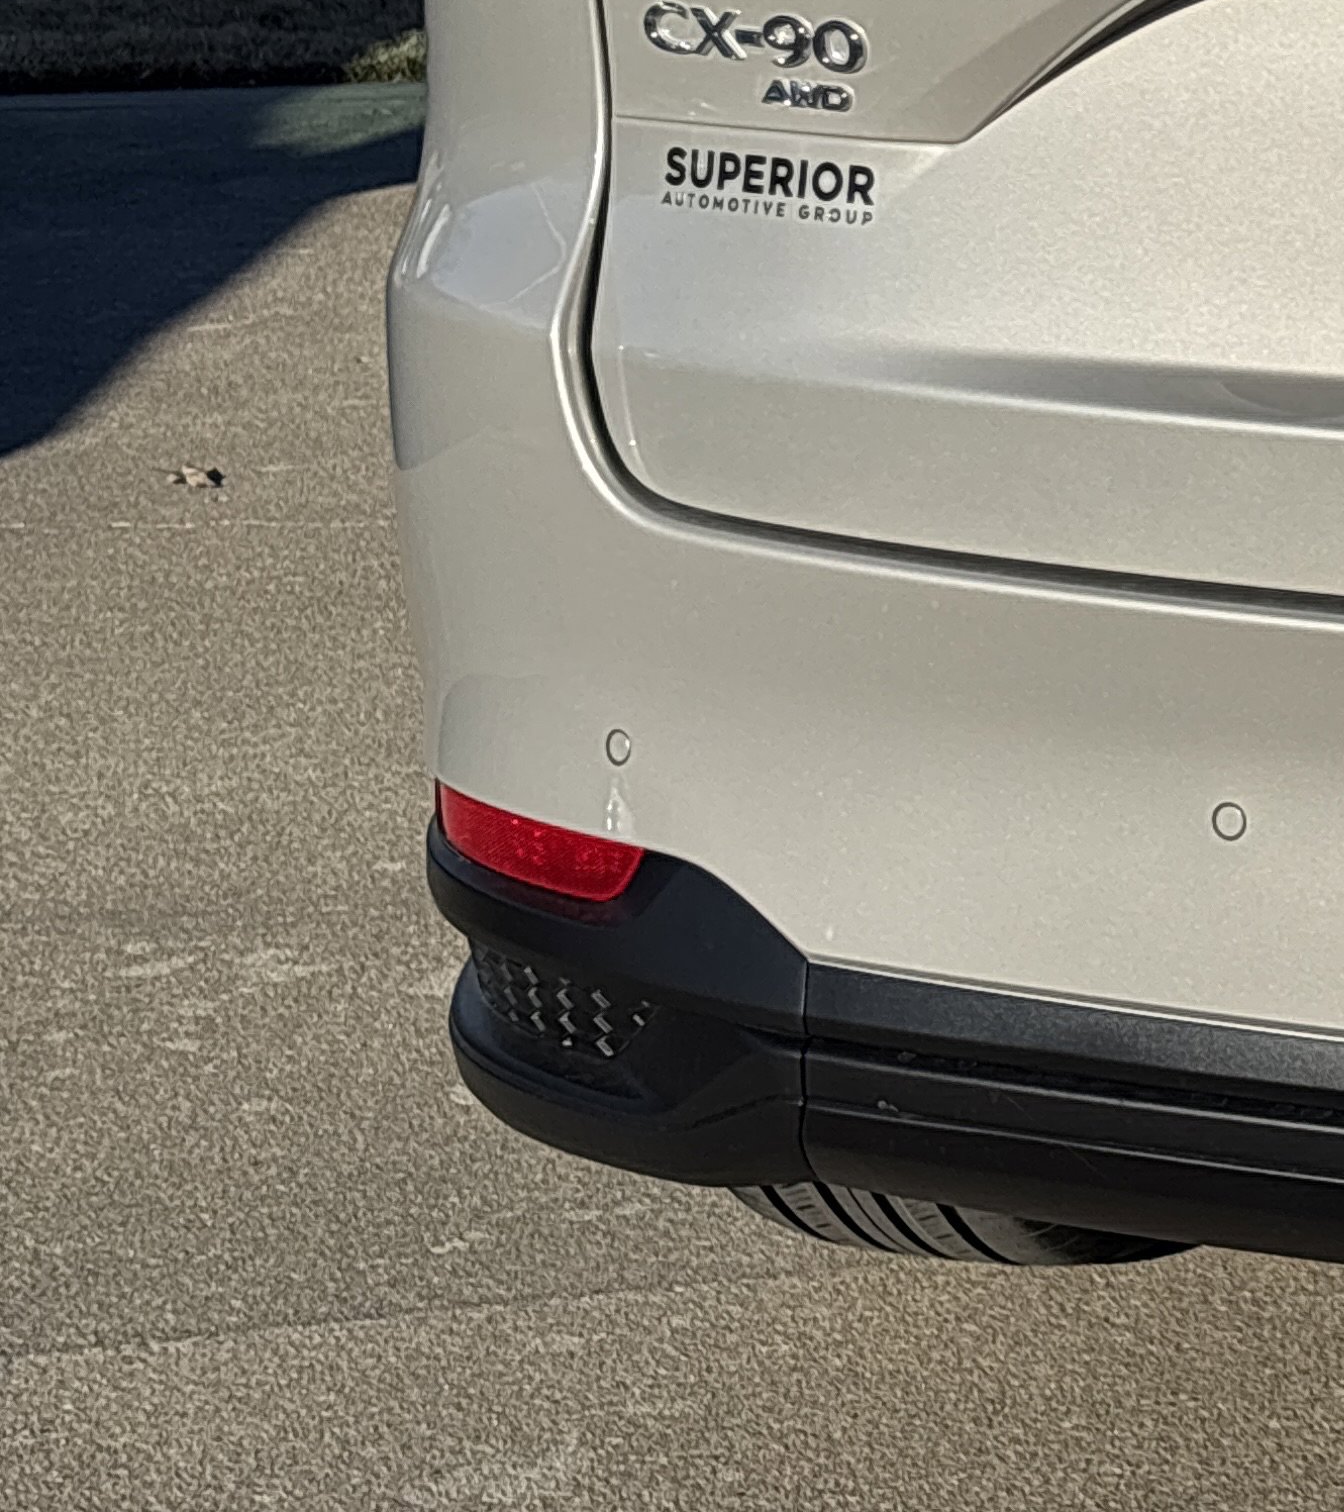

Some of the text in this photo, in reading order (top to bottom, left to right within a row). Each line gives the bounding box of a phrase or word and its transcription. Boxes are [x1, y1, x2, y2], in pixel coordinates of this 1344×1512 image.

[643, 0, 867, 75] CX-90
[762, 80, 853, 112] AWD
[665, 147, 874, 205] SUPERIOR
[662, 192, 873, 225] AUTOMOTIVE GROUP
